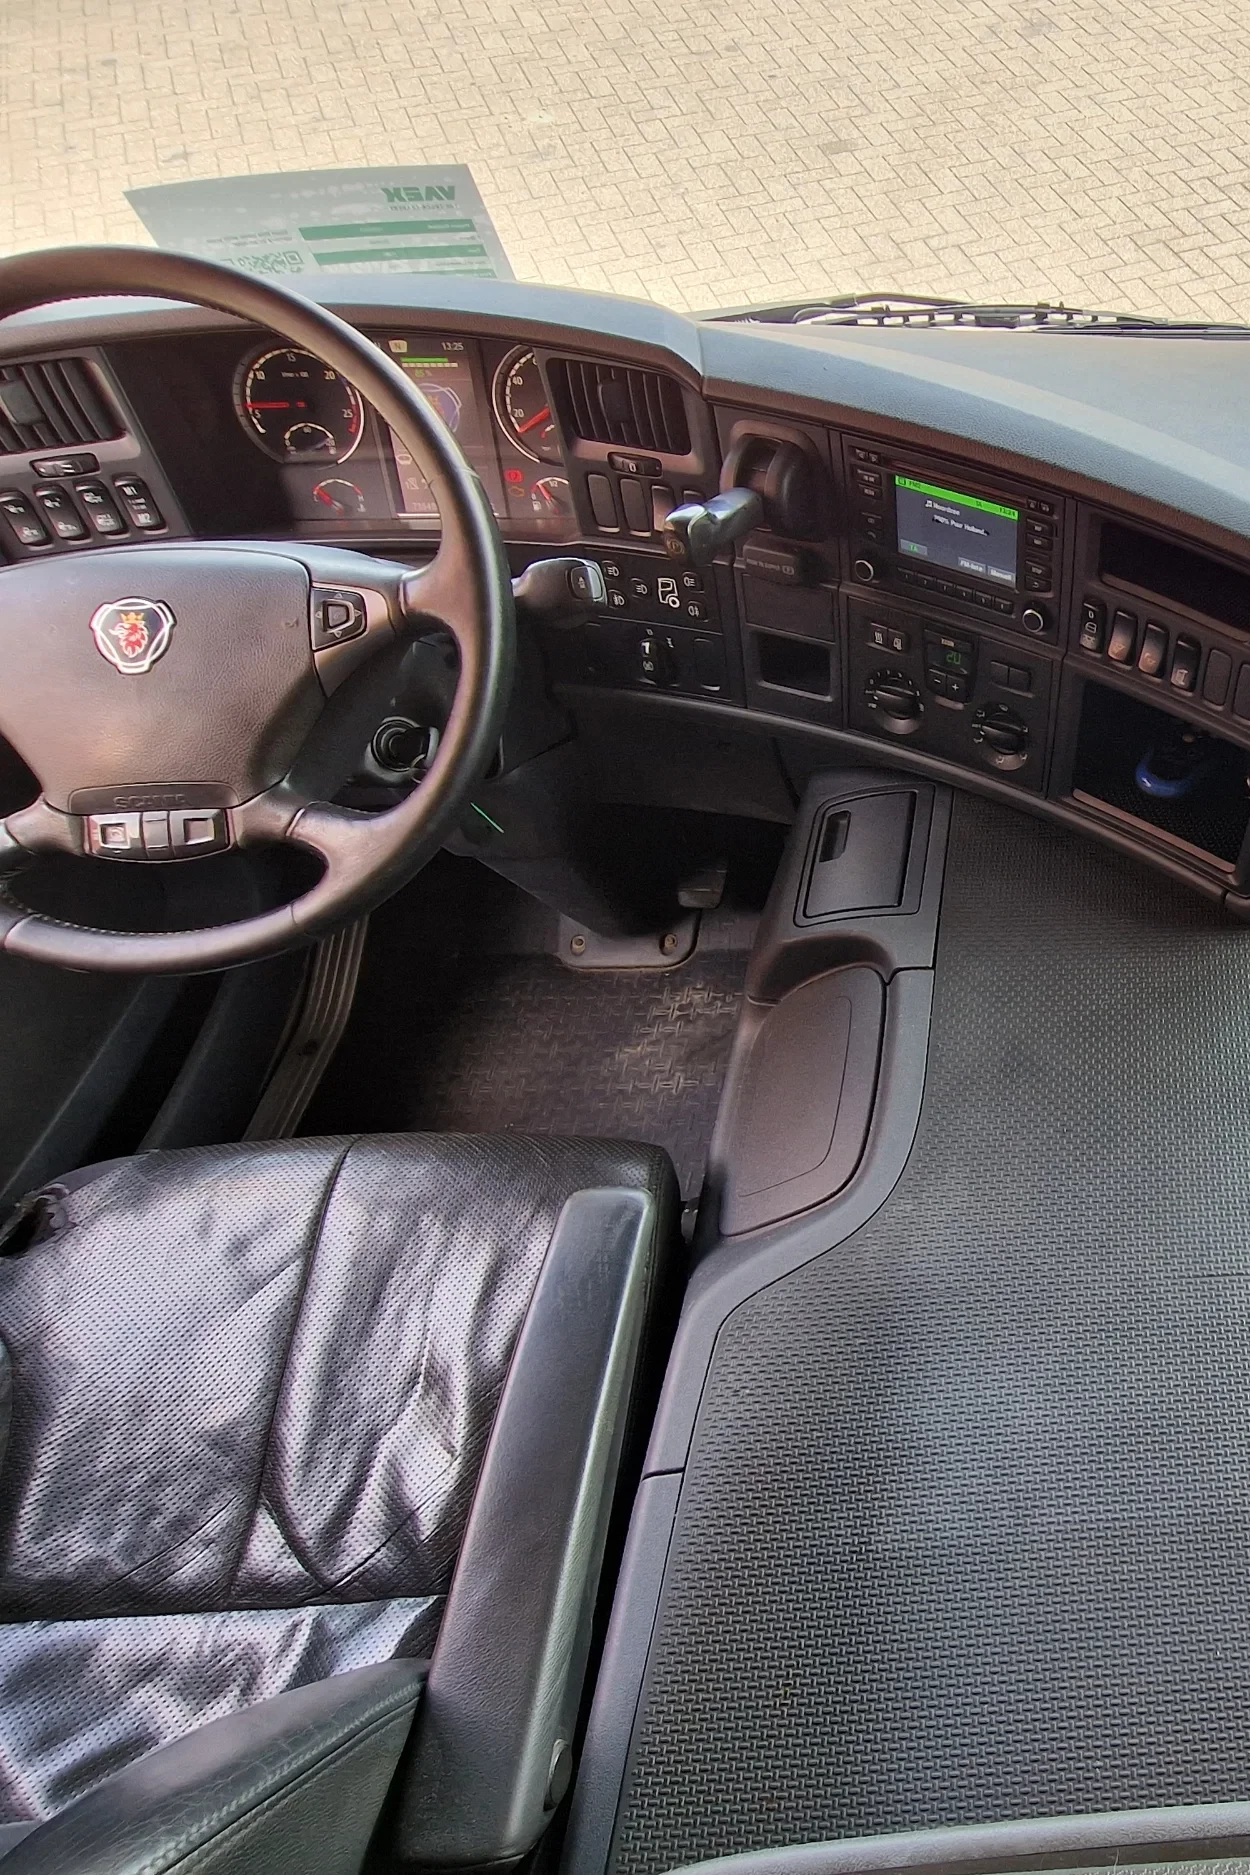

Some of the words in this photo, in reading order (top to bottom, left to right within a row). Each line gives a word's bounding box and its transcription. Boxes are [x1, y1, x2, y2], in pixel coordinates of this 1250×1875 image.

[441, 342, 464, 351] 13:25
[286, 353, 297, 362] 15
[255, 370, 266, 380] 10
[324, 370, 336, 380] 20
[512, 376, 524, 386] 40
[255, 409, 262, 418] 5
[342, 408, 353, 418] 25
[513, 408, 525, 418] 20
[946, 651, 962, 665] 20
